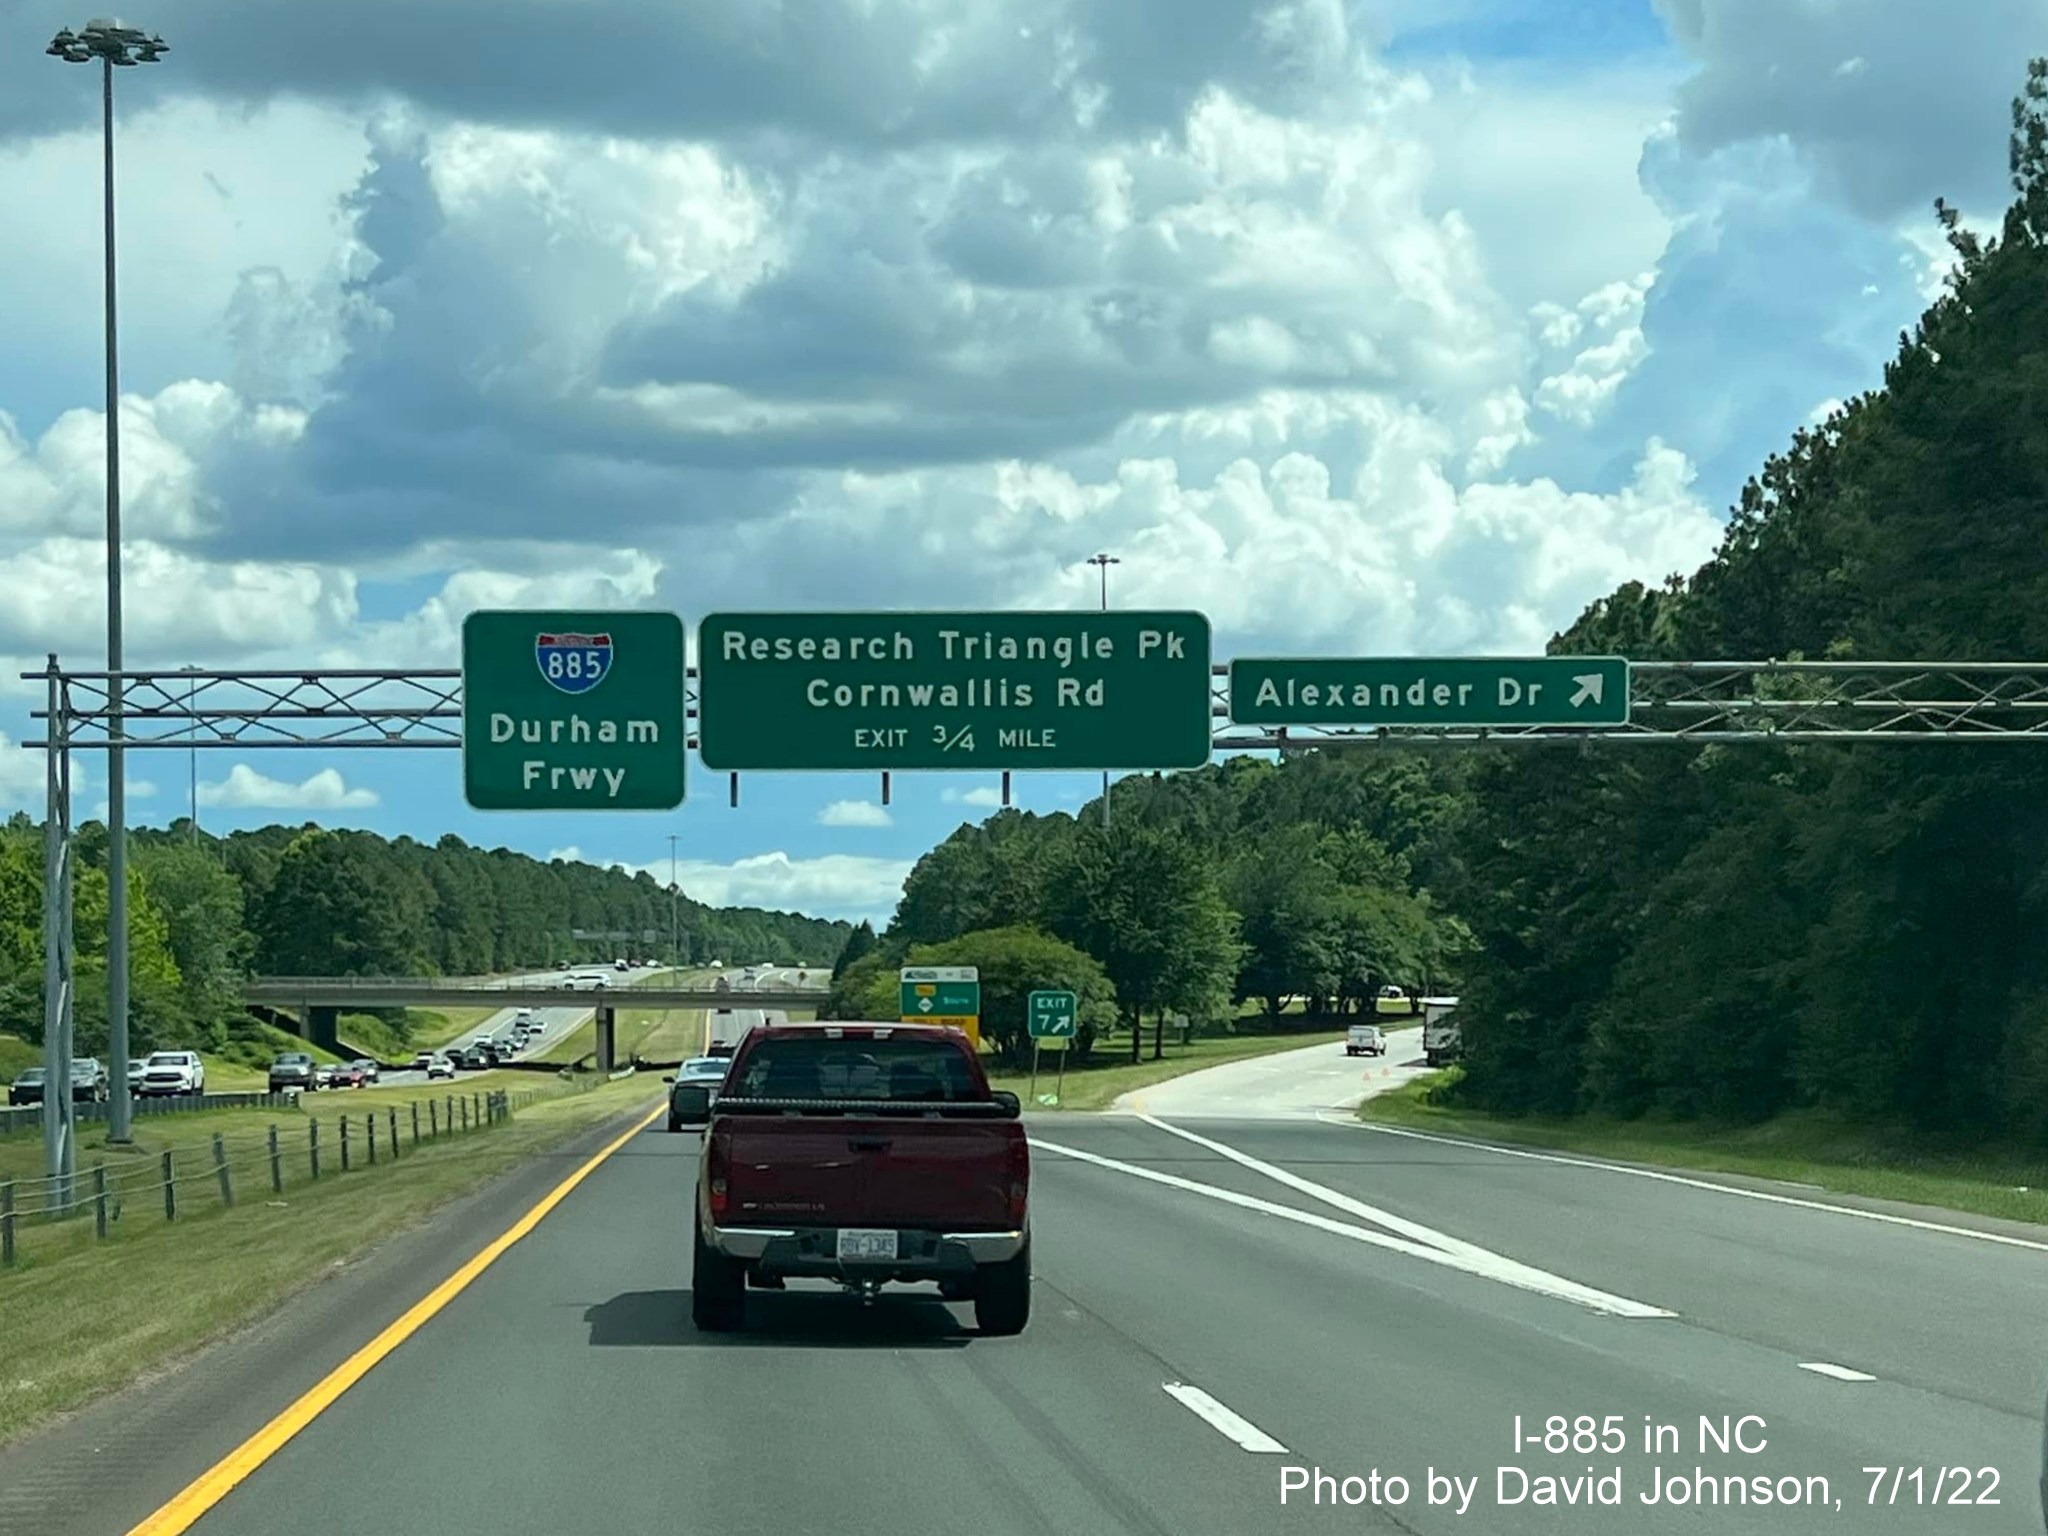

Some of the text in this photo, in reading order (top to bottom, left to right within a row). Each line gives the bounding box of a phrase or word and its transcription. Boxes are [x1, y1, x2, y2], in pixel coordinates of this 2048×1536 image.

[723, 630, 1185, 668] Research Triangle Pk
[549, 651, 601, 678] 885
[807, 678, 1104, 707] Cornwallis Rd
[1255, 677, 1542, 707] Alexander Dr
[490, 713, 659, 743] Durham
[855, 729, 908, 748] EXIT
[998, 729, 1056, 748] MILE
[523, 761, 625, 797] Frwy
[1037, 998, 1067, 1009] EXIT
[1038, 1015, 1050, 1030] 7
